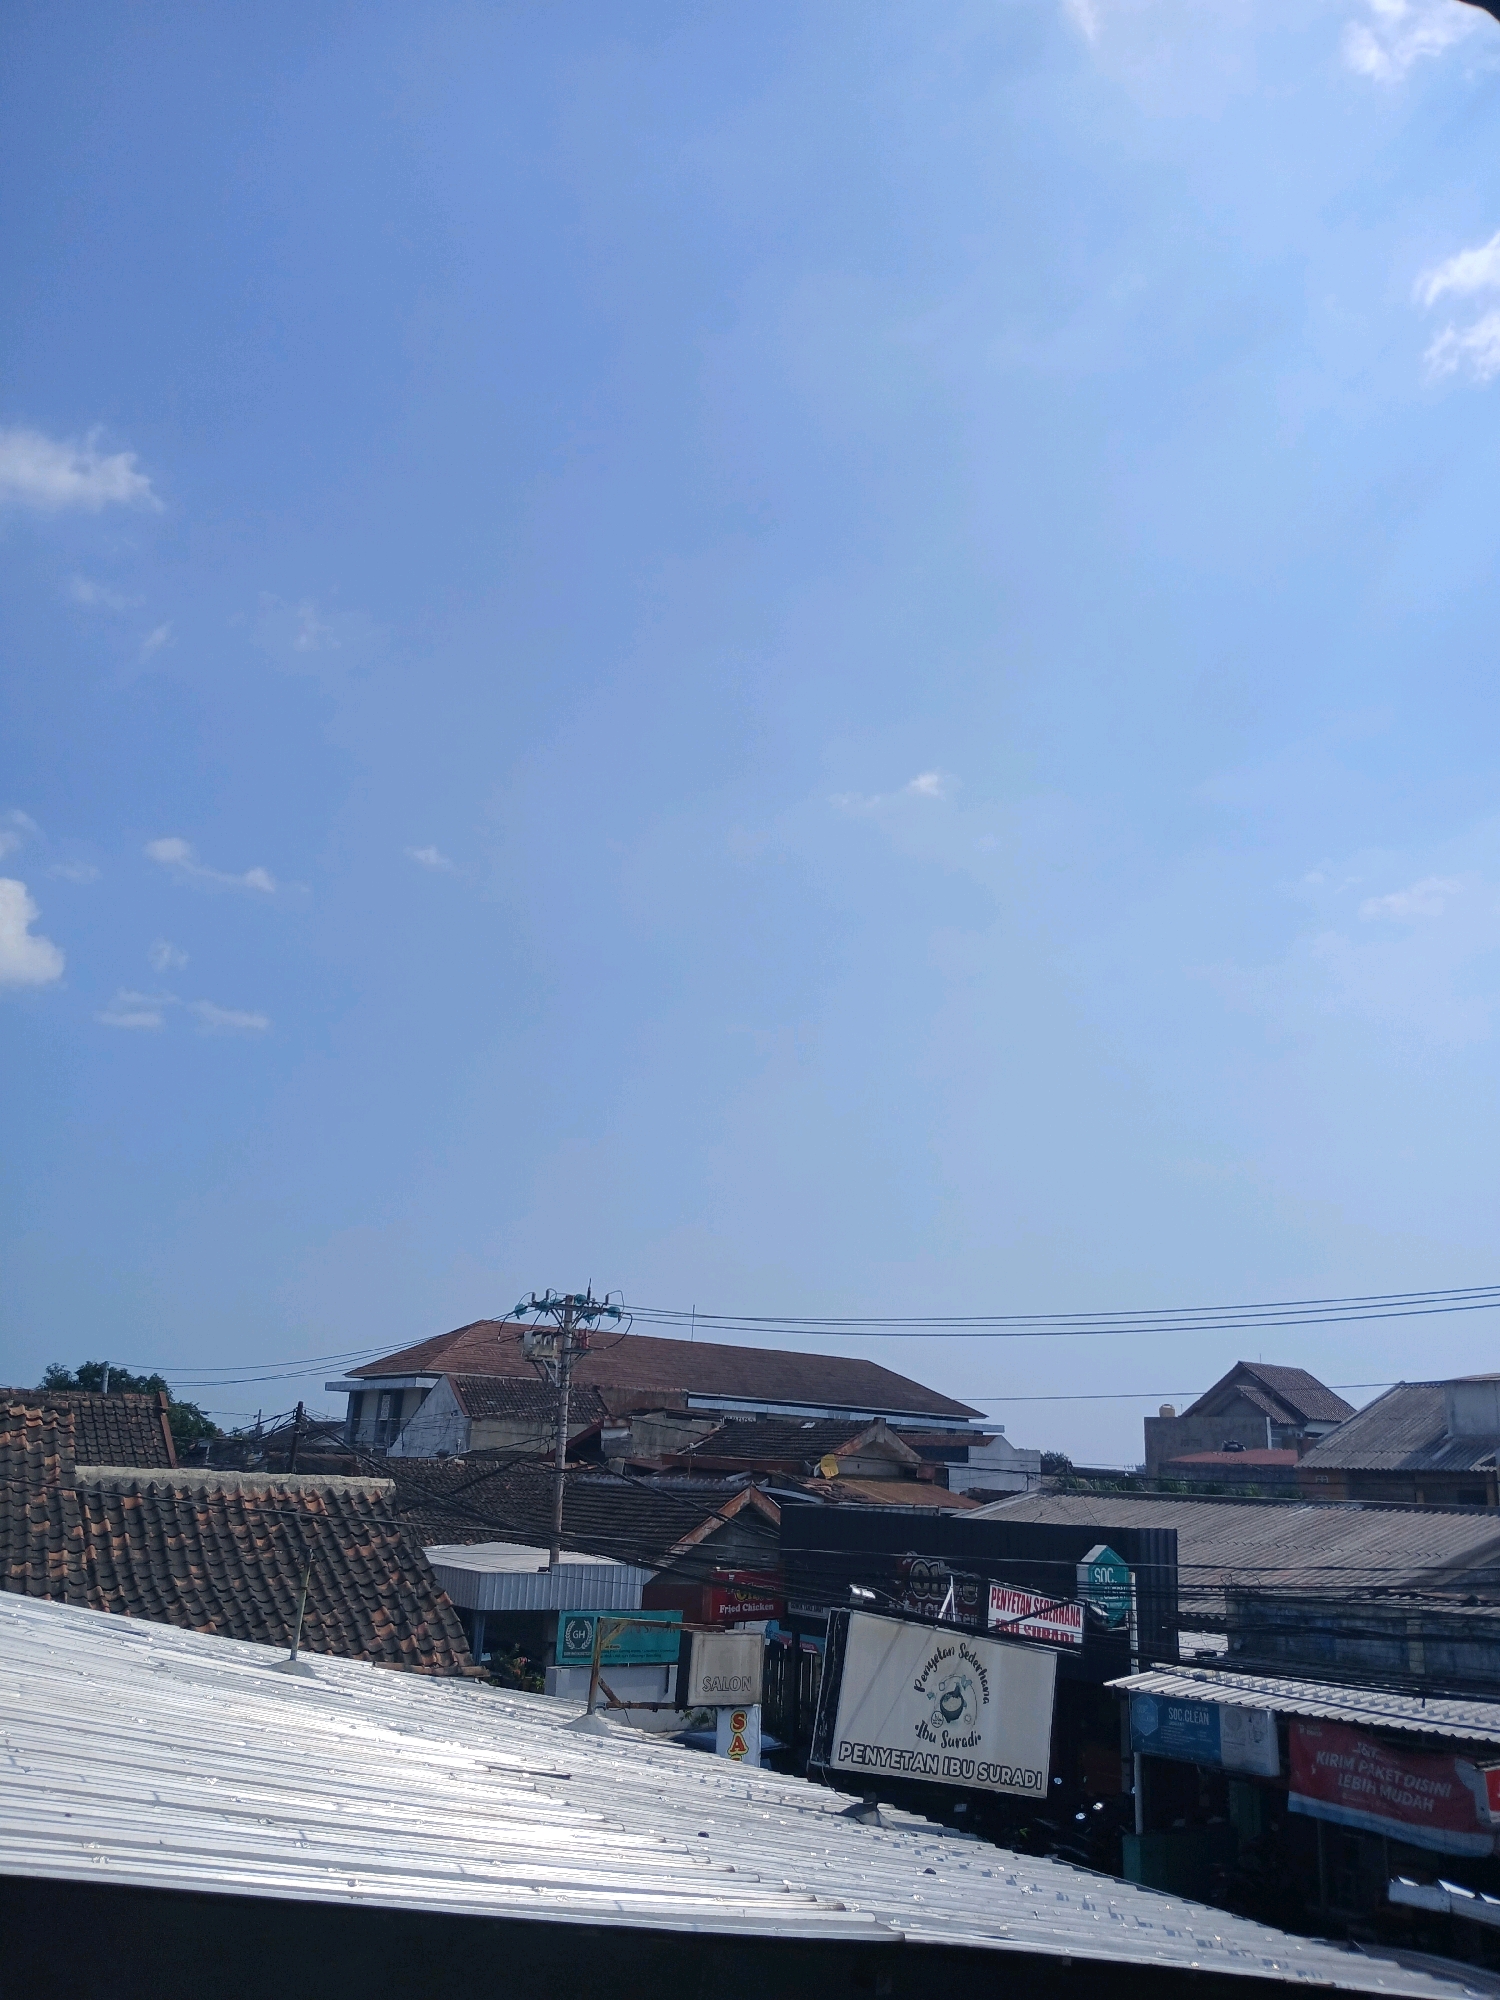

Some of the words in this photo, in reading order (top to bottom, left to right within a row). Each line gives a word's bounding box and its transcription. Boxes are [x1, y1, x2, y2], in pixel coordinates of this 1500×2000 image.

[720, 1603, 740, 1615] Fried
[742, 1603, 774, 1613] Chicken
[990, 1586, 1033, 1616] PENYETAN
[572, 1630, 586, 1639] GH
[702, 1675, 752, 1693] SALON
[913, 1646, 955, 1693] Penyetan
[958, 1642, 990, 1705] Sederhana
[1168, 1706, 1210, 1726] SOC.CLEAN
[727, 1709, 749, 1762] SA
[838, 1741, 939, 1776] PENYETAN
[942, 1755, 975, 1780] IBU
[976, 1761, 1043, 1790] SURADI
[1316, 1750, 1355, 1770] KIRIM
[1357, 1760, 1403, 1784] PAKET
[1403, 1774, 1452, 1798] DISINI
[1338, 1772, 1377, 1794] LEBIH
[1379, 1784, 1435, 1813] MUDAH
